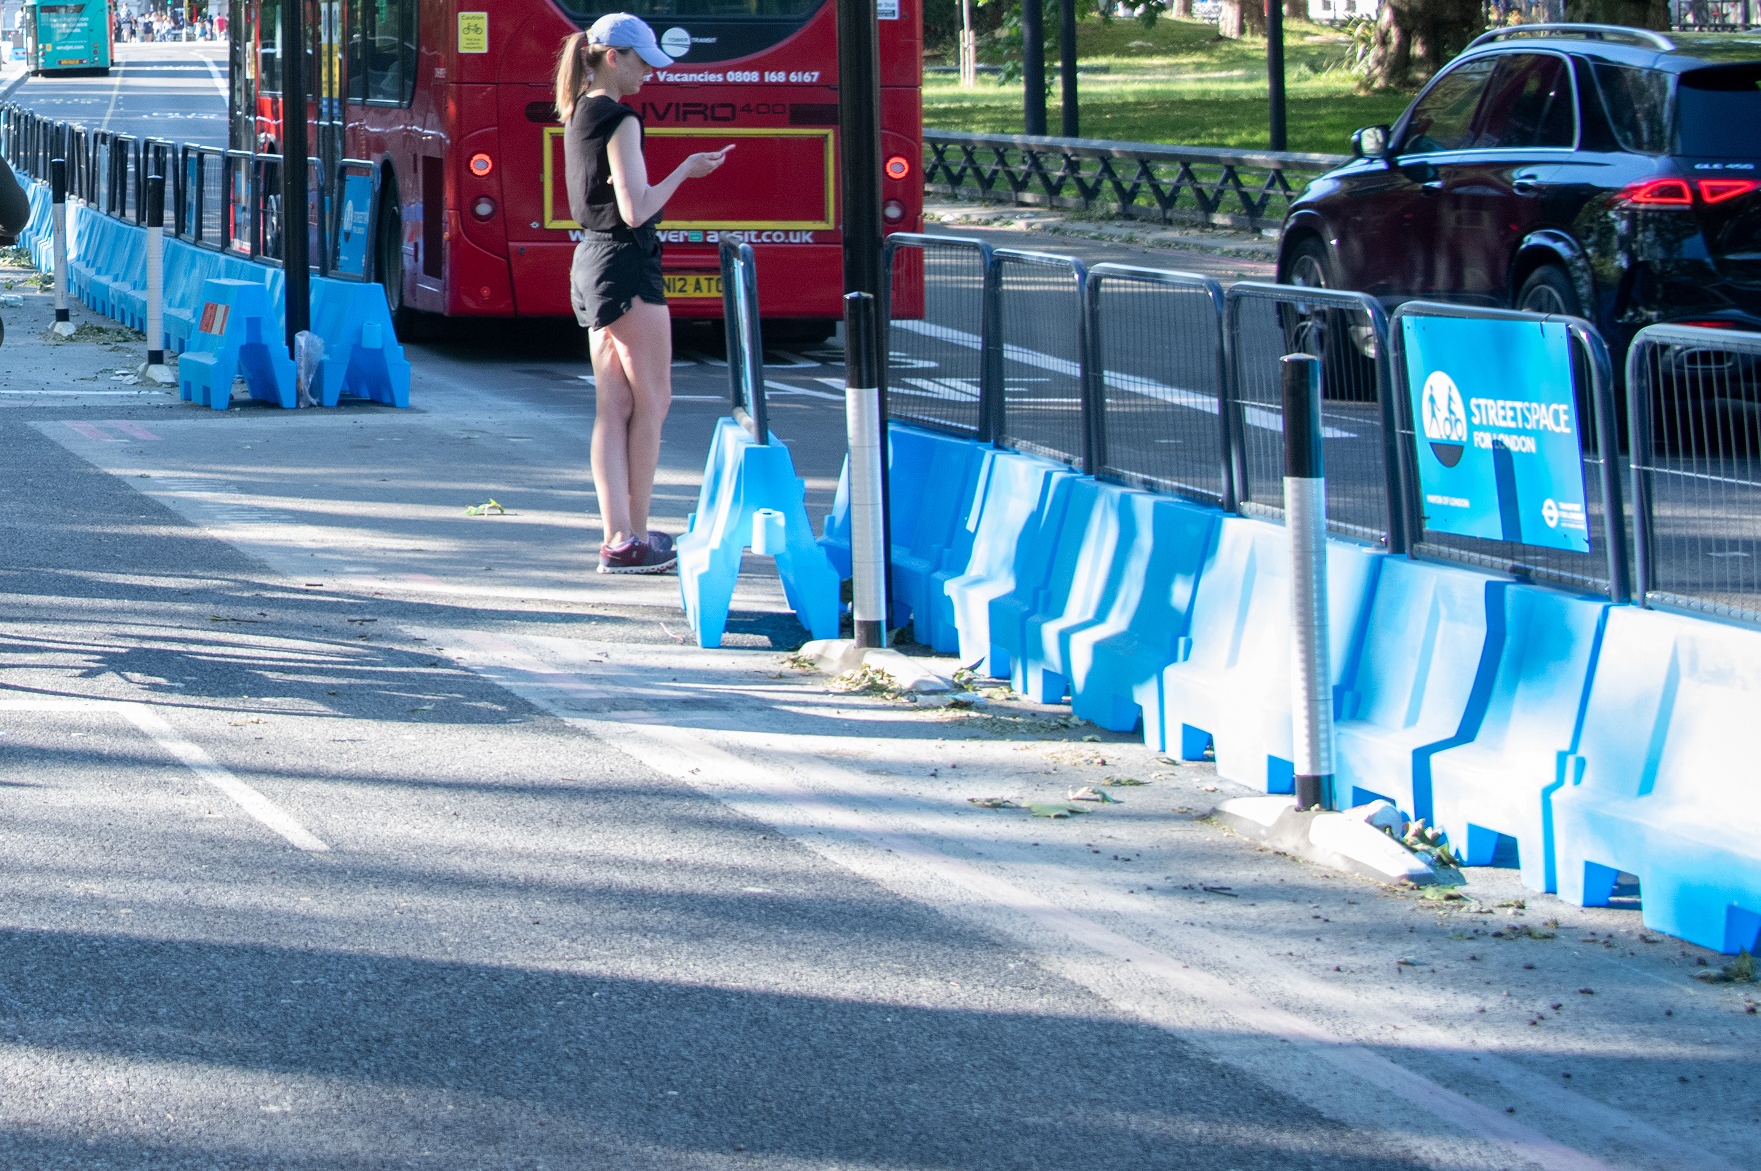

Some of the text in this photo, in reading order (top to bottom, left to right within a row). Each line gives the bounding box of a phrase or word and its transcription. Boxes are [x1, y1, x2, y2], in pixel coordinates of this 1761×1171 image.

[656, 70, 724, 83] Vacancies
[726, 71, 760, 83] 0808
[764, 71, 786, 83] 168
[788, 71, 821, 83] 6167
[1470, 397, 1571, 434] STREETSPACE
[1473, 431, 1537, 454] FOR LONDON
